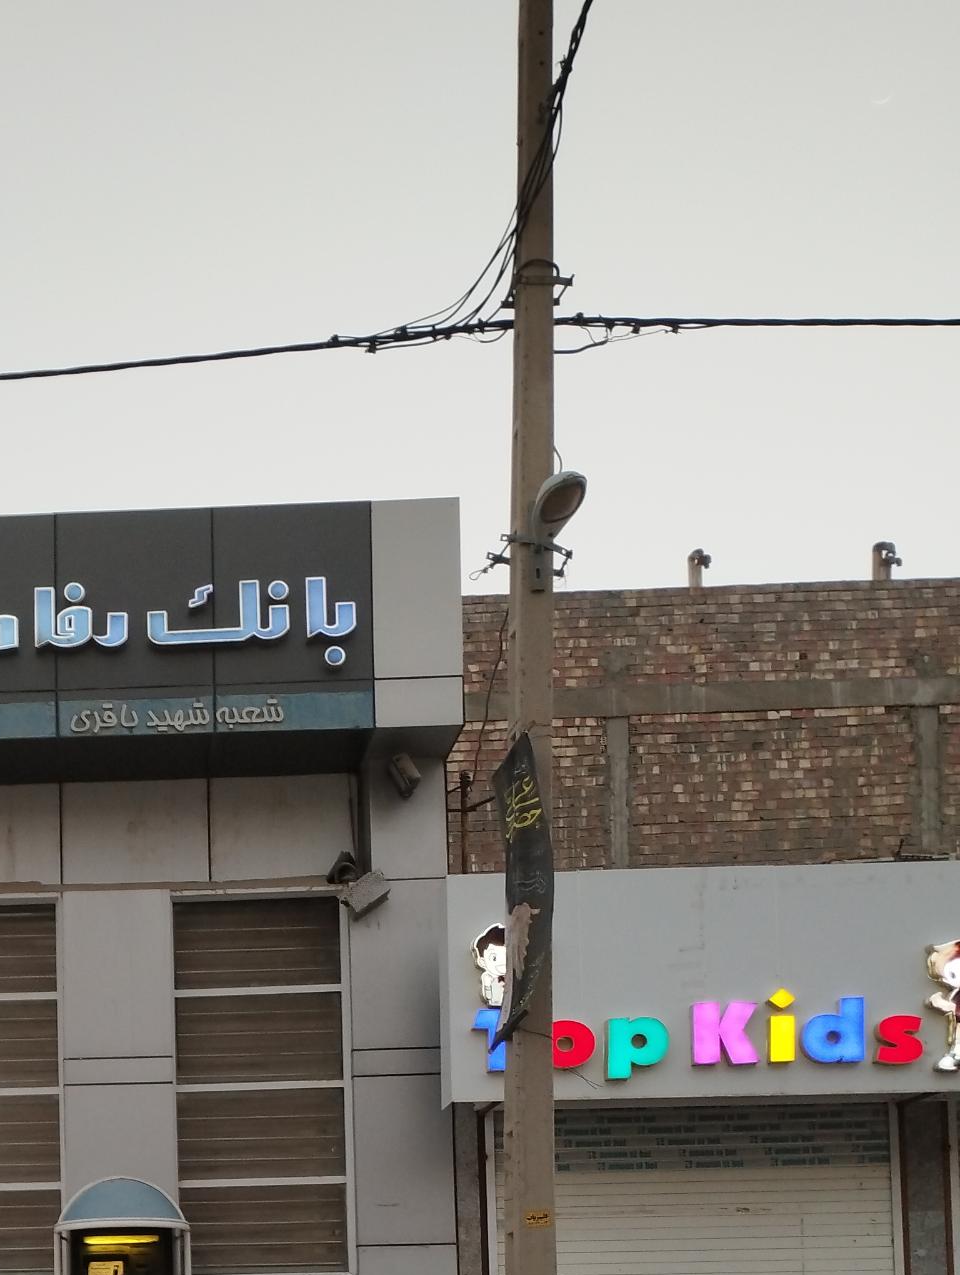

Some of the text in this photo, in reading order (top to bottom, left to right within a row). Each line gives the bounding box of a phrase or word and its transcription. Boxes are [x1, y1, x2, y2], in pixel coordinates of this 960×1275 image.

[146, 576, 357, 667] بانک
[146, 698, 210, 732] شهید
[215, 696, 285, 730] شعبه
[690, 988, 924, 1066] Kids
